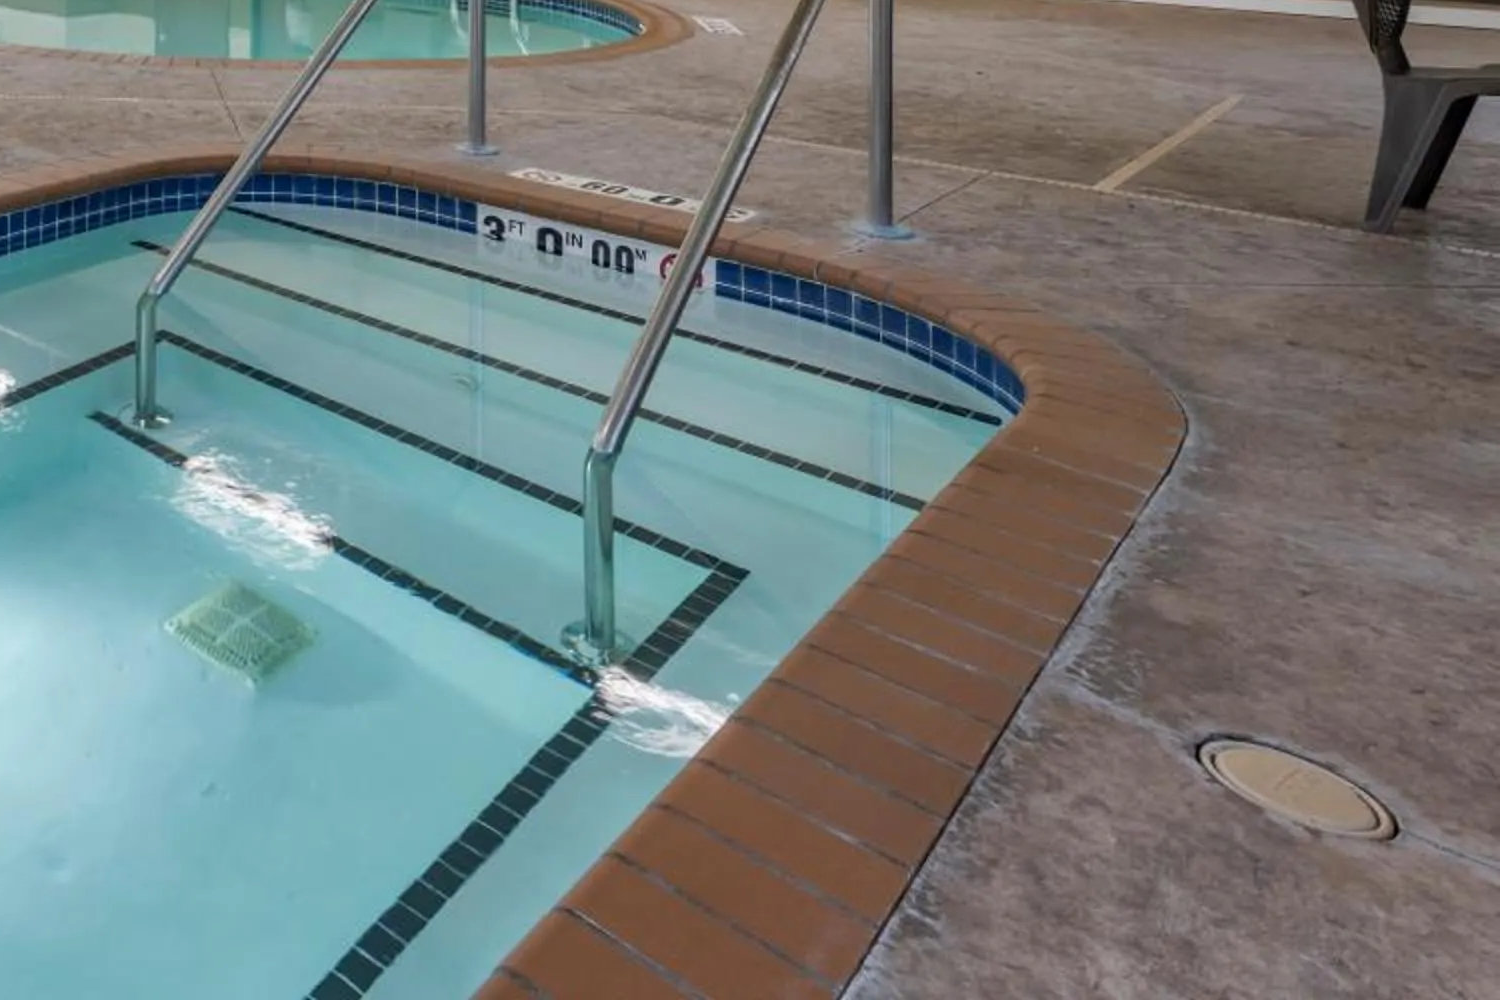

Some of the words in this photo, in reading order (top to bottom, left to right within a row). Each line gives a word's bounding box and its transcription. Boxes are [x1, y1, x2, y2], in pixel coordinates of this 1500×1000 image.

[483, 215, 505, 241] 3
[508, 219, 525, 236] FT
[537, 227, 563, 256] 0
[565, 231, 583, 248] IN
[635, 247, 647, 261] M
